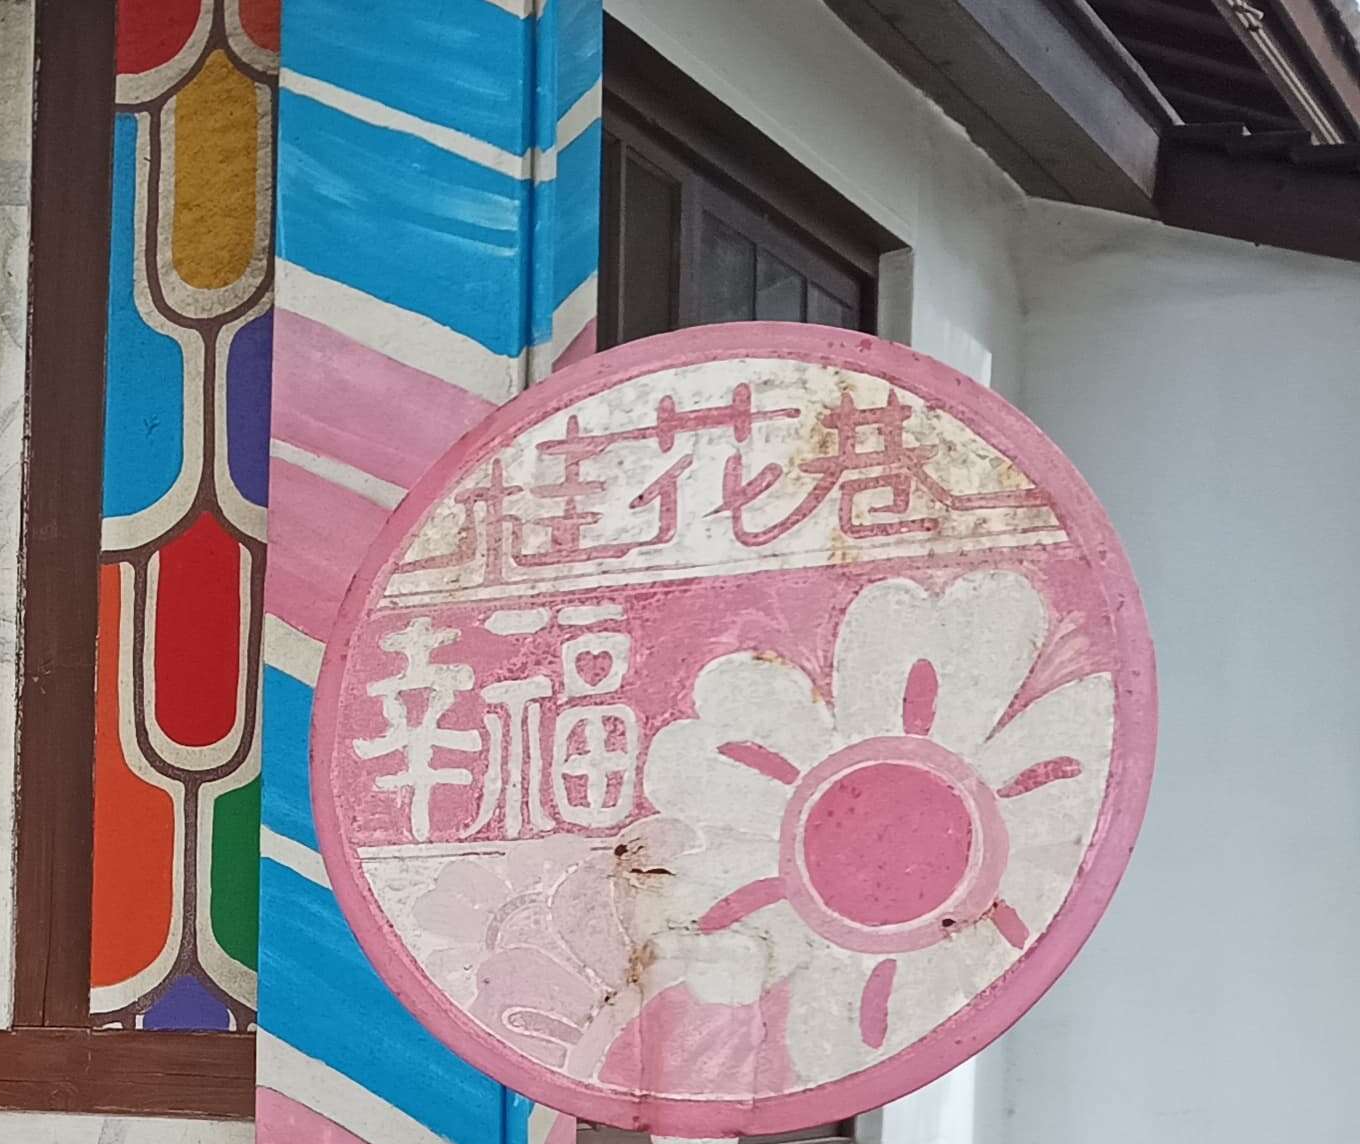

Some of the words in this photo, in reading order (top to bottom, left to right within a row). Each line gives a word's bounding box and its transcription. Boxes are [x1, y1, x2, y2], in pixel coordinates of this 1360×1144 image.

[402, 382, 1054, 582] 桂花巷
[353, 605, 644, 843] 幸福
